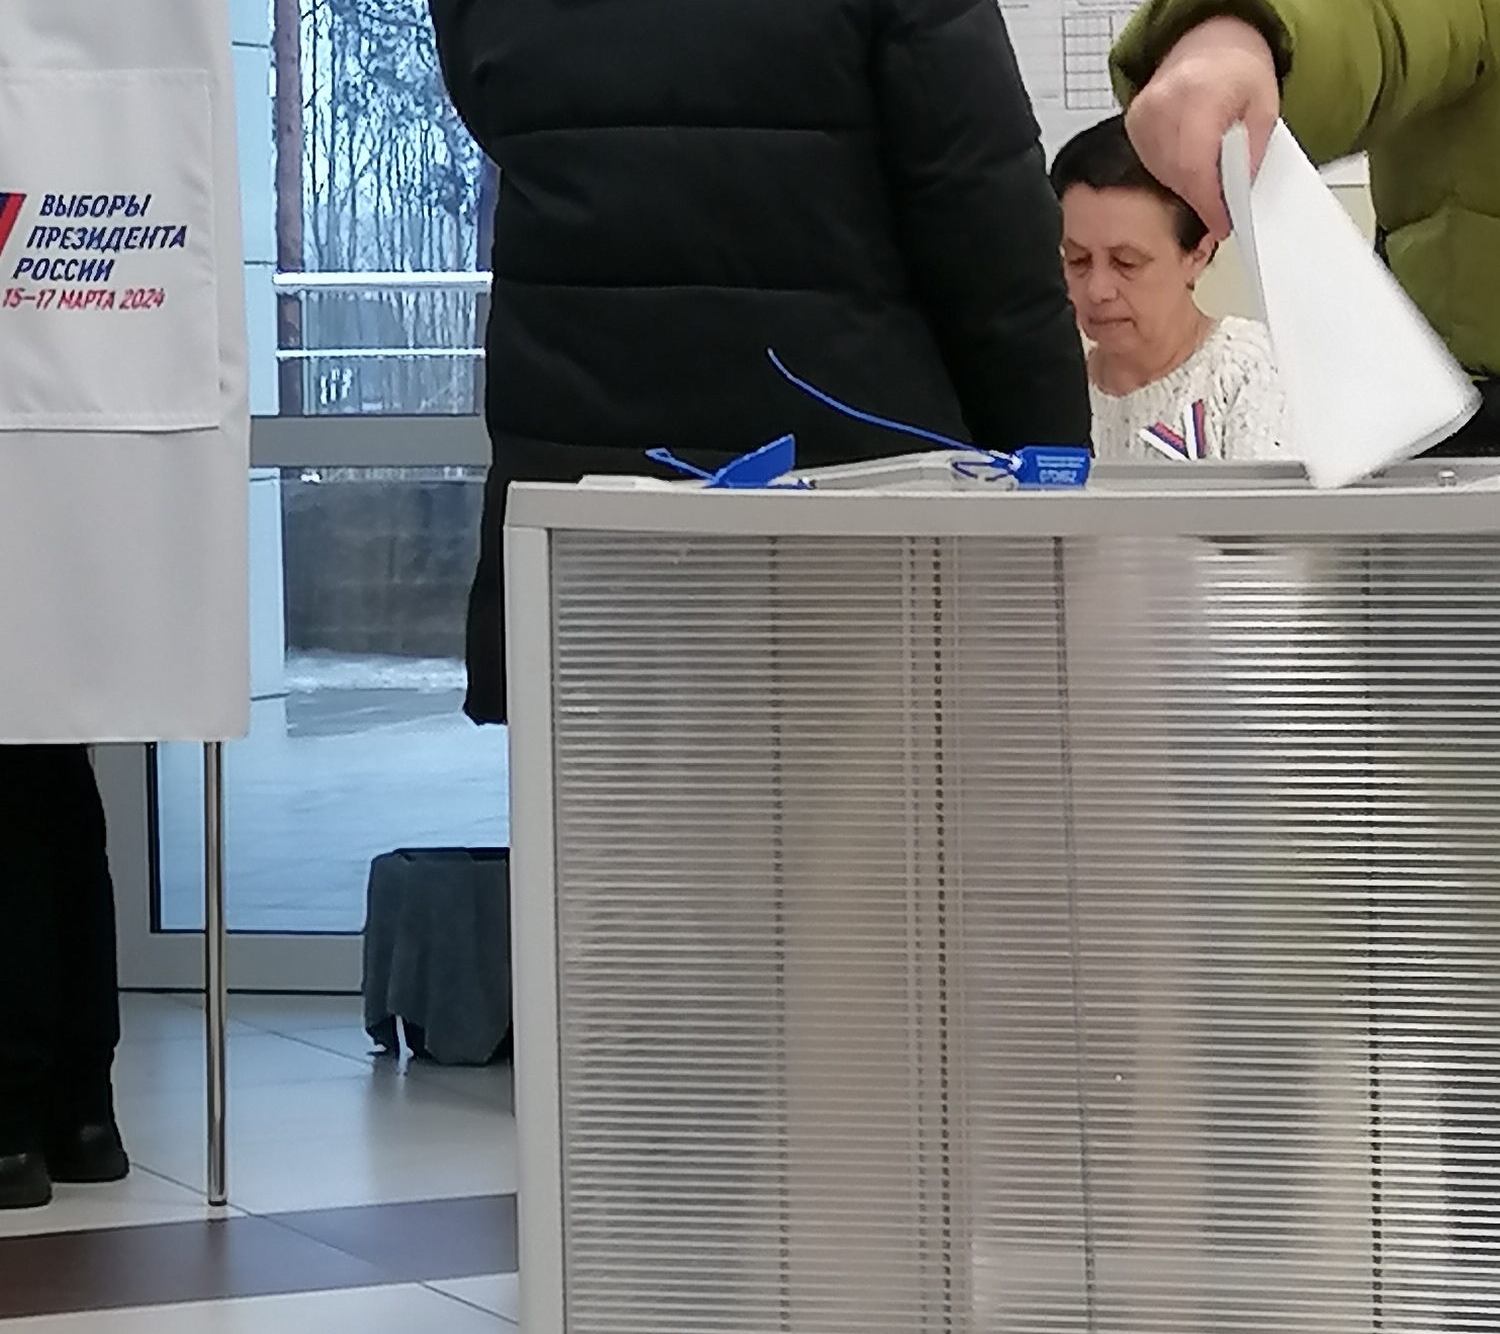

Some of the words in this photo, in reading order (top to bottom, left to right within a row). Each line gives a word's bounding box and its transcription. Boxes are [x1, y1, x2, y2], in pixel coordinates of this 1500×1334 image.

[38, 193, 152, 218] ВЫБОРЫ
[26, 224, 188, 253] ПРЕЗИДЕНТА
[12, 257, 116, 282] РОССИИ
[57, 288, 116, 309] МАРТА
[119, 287, 166, 309] 2024
